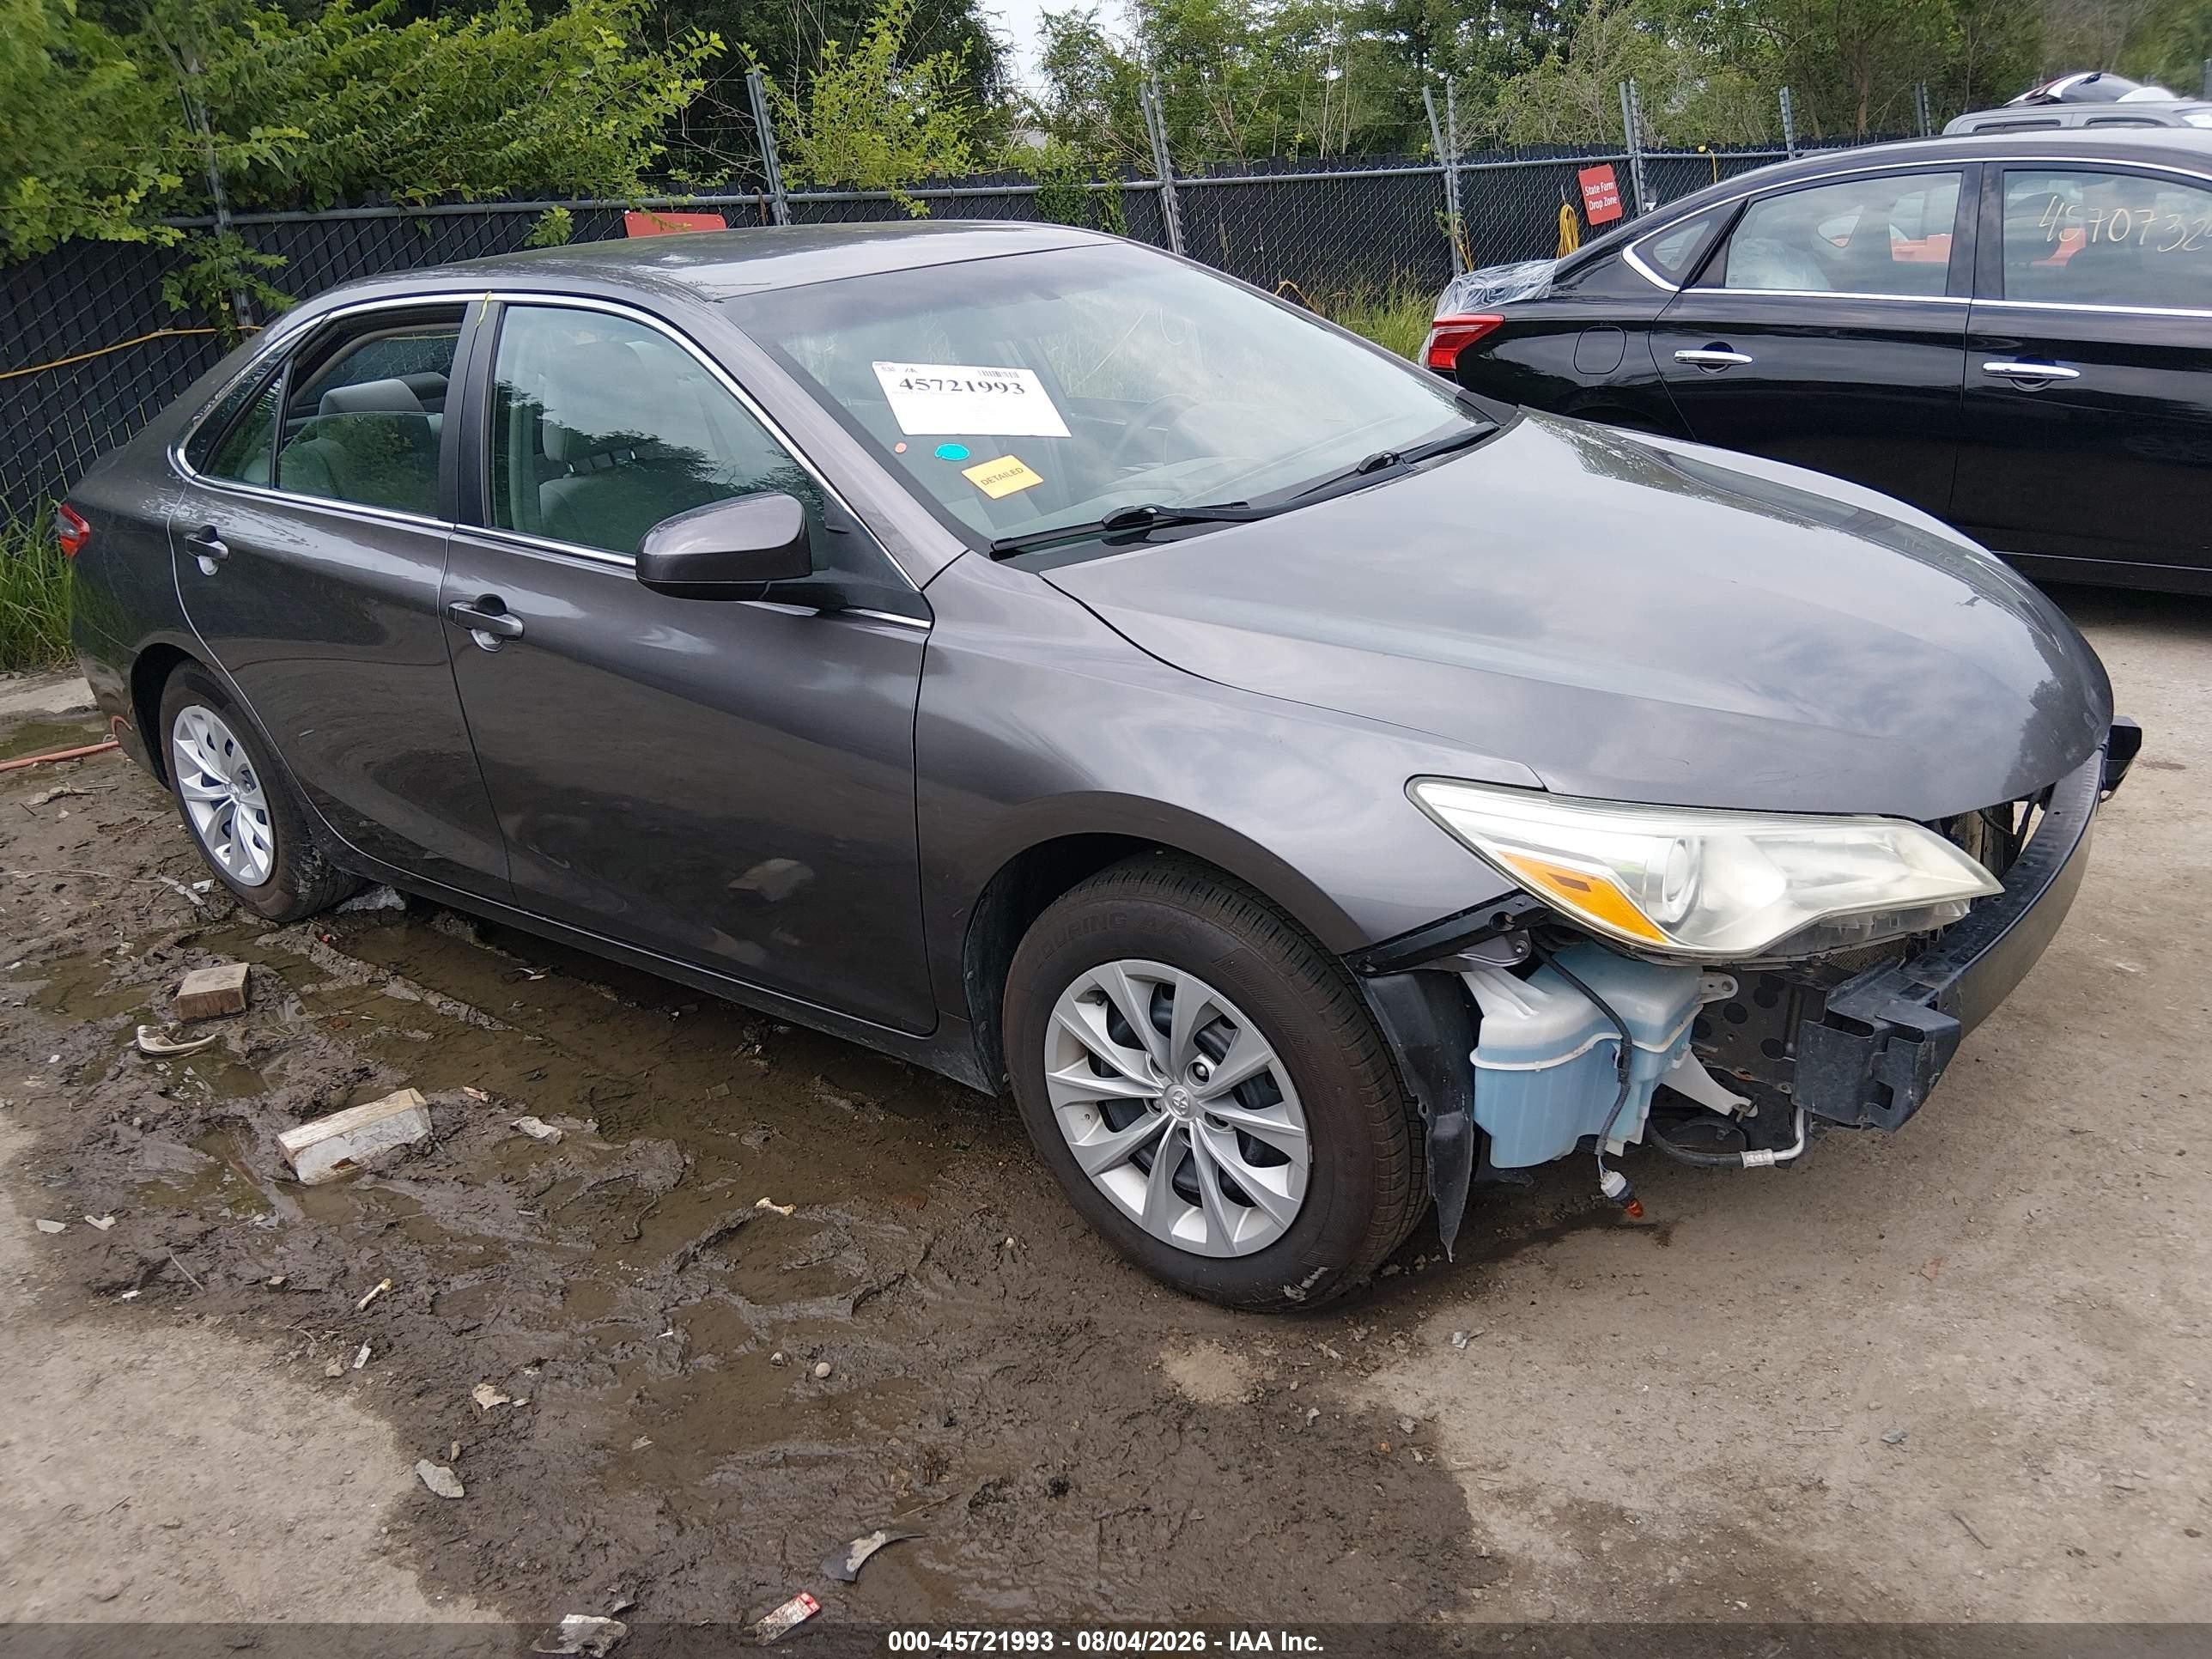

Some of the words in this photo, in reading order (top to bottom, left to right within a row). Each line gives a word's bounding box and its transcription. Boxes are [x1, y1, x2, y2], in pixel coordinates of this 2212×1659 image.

[1584, 185, 1601, 197] State
[1600, 181, 1614, 192] Farm
[1588, 199, 1603, 211] Drop
[1603, 196, 1618, 207] Zone
[898, 377, 1026, 396] 45721993
[980, 466, 1025, 486] DETAILED
